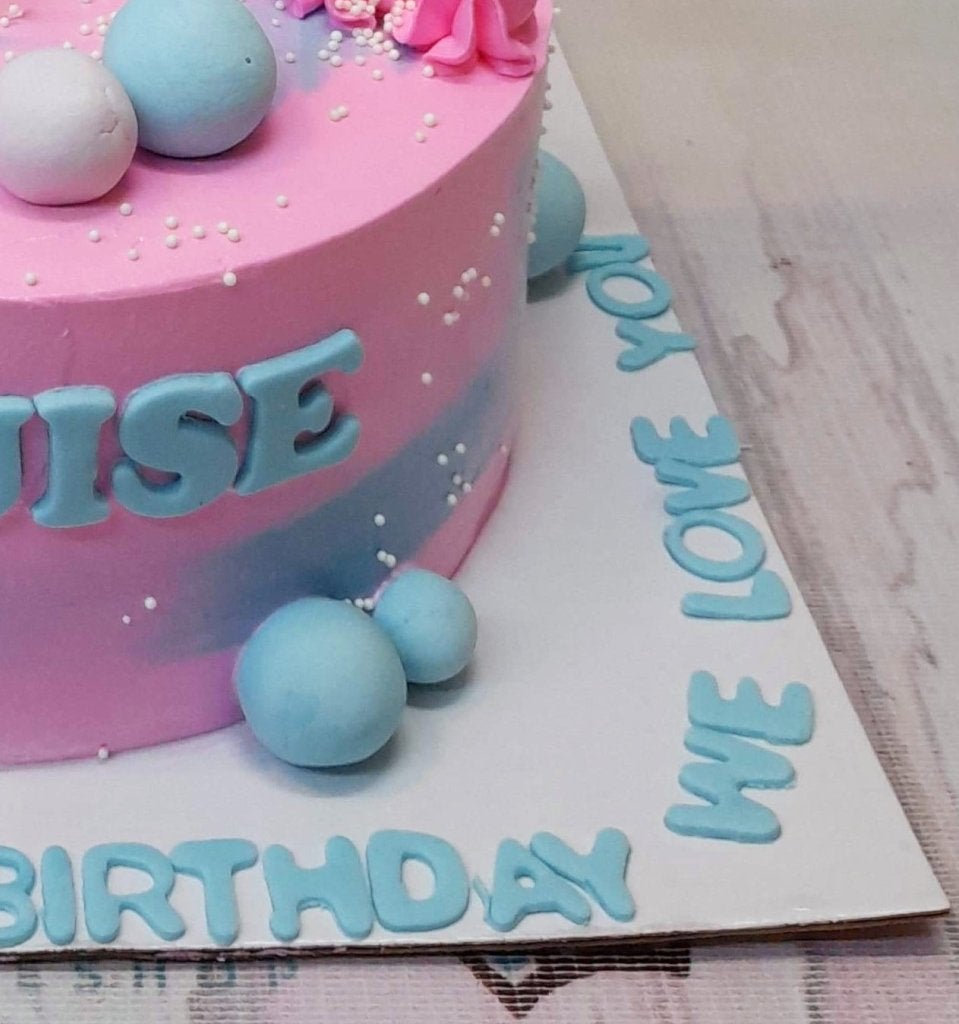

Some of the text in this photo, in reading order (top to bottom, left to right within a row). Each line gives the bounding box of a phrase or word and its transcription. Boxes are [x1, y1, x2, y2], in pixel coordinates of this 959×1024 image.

[567, 233, 815, 844] WE LOVE YOU
